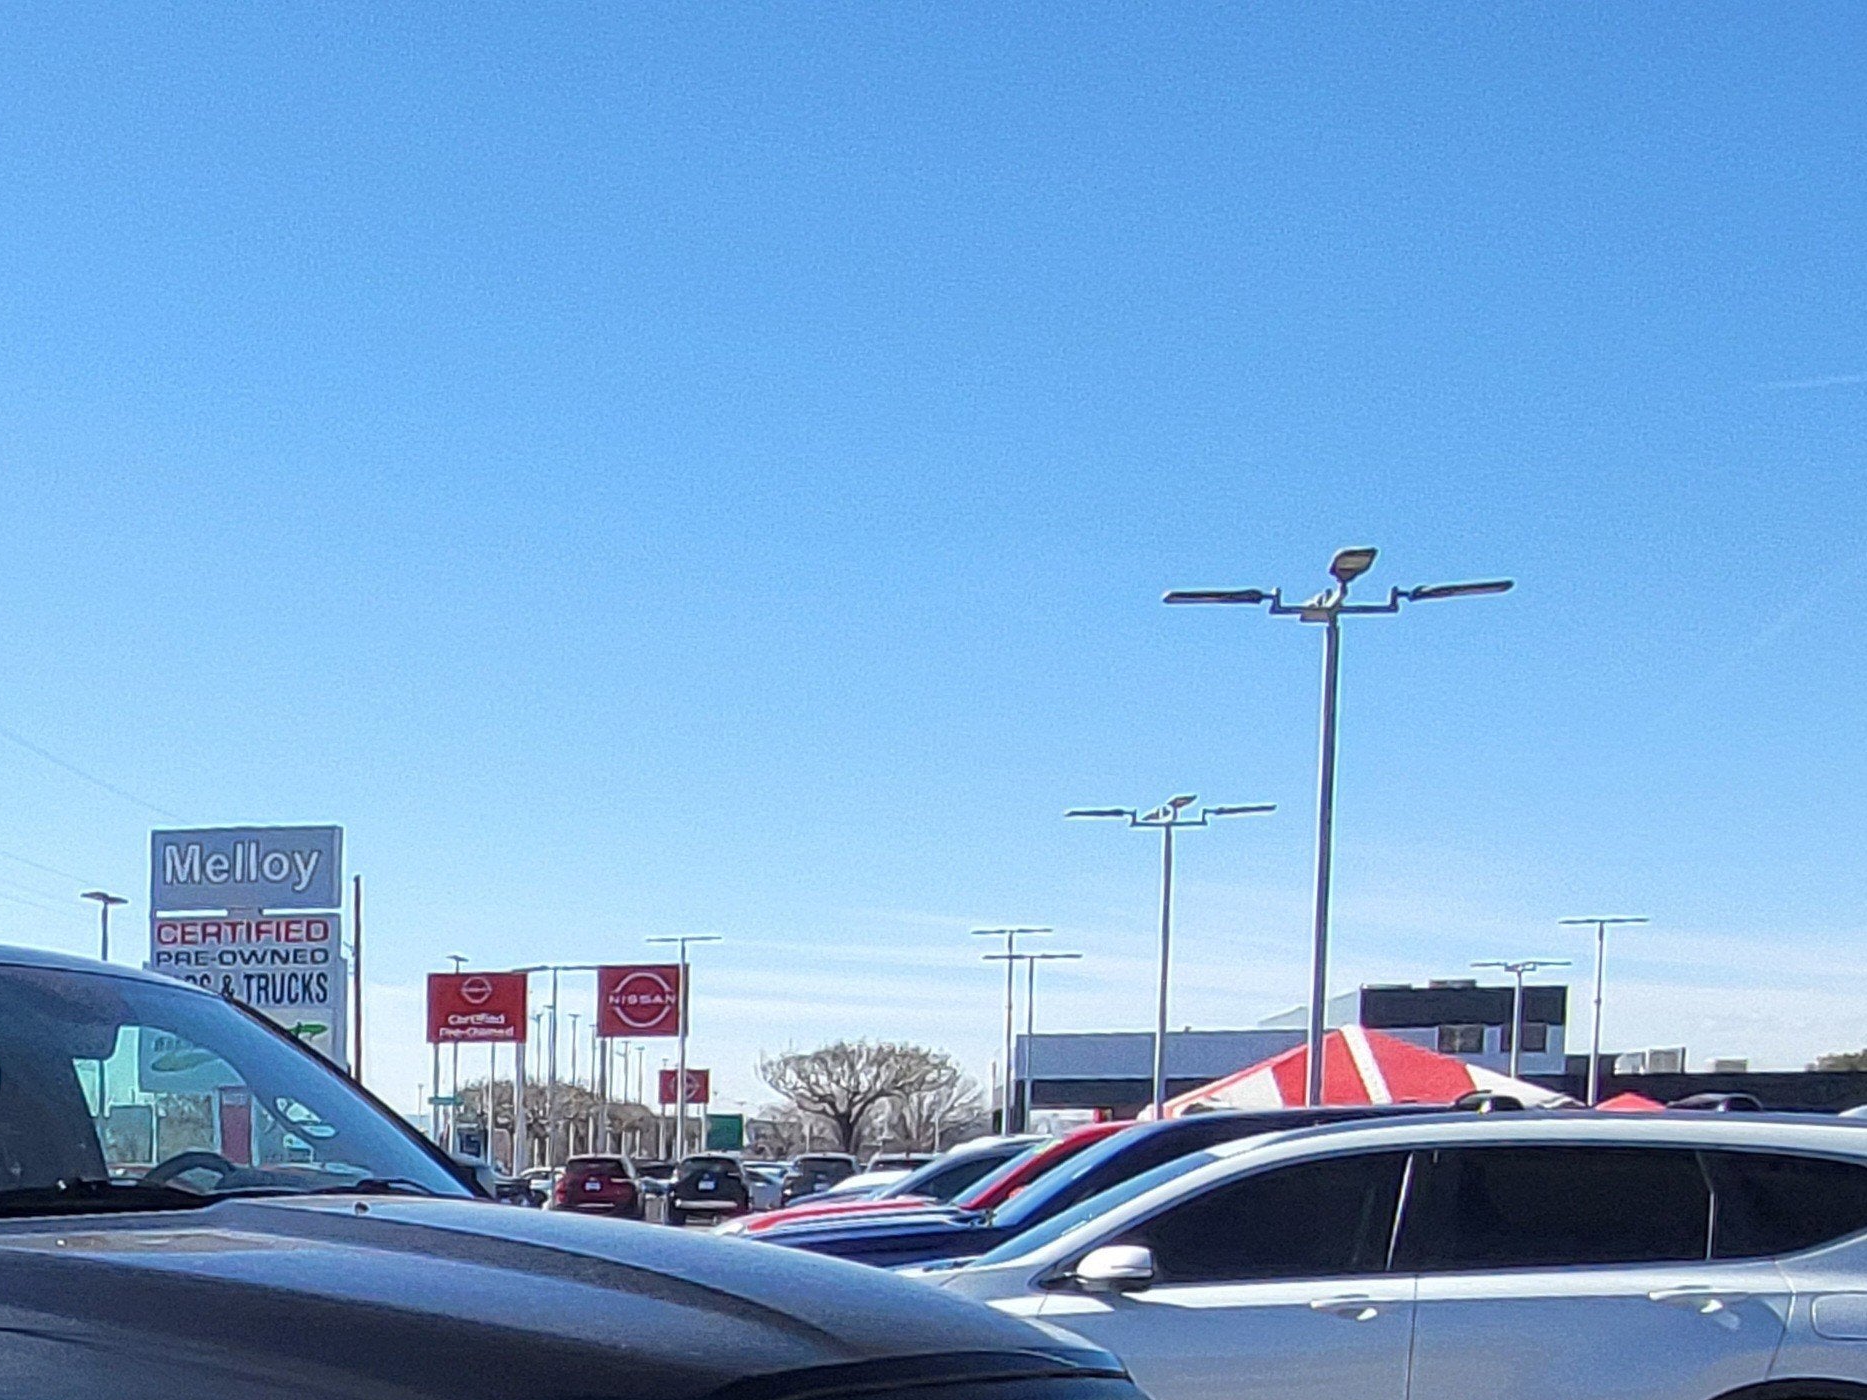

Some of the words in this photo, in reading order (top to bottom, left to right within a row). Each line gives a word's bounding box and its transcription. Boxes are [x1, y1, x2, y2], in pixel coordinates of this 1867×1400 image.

[163, 840, 322, 892] Melloy
[156, 919, 330, 946] CERTIFIED
[156, 947, 330, 967] PRE-OWNED
[220, 973, 235, 998] &
[243, 972, 329, 1006] TRUCKS
[608, 993, 676, 1005] NISSAN
